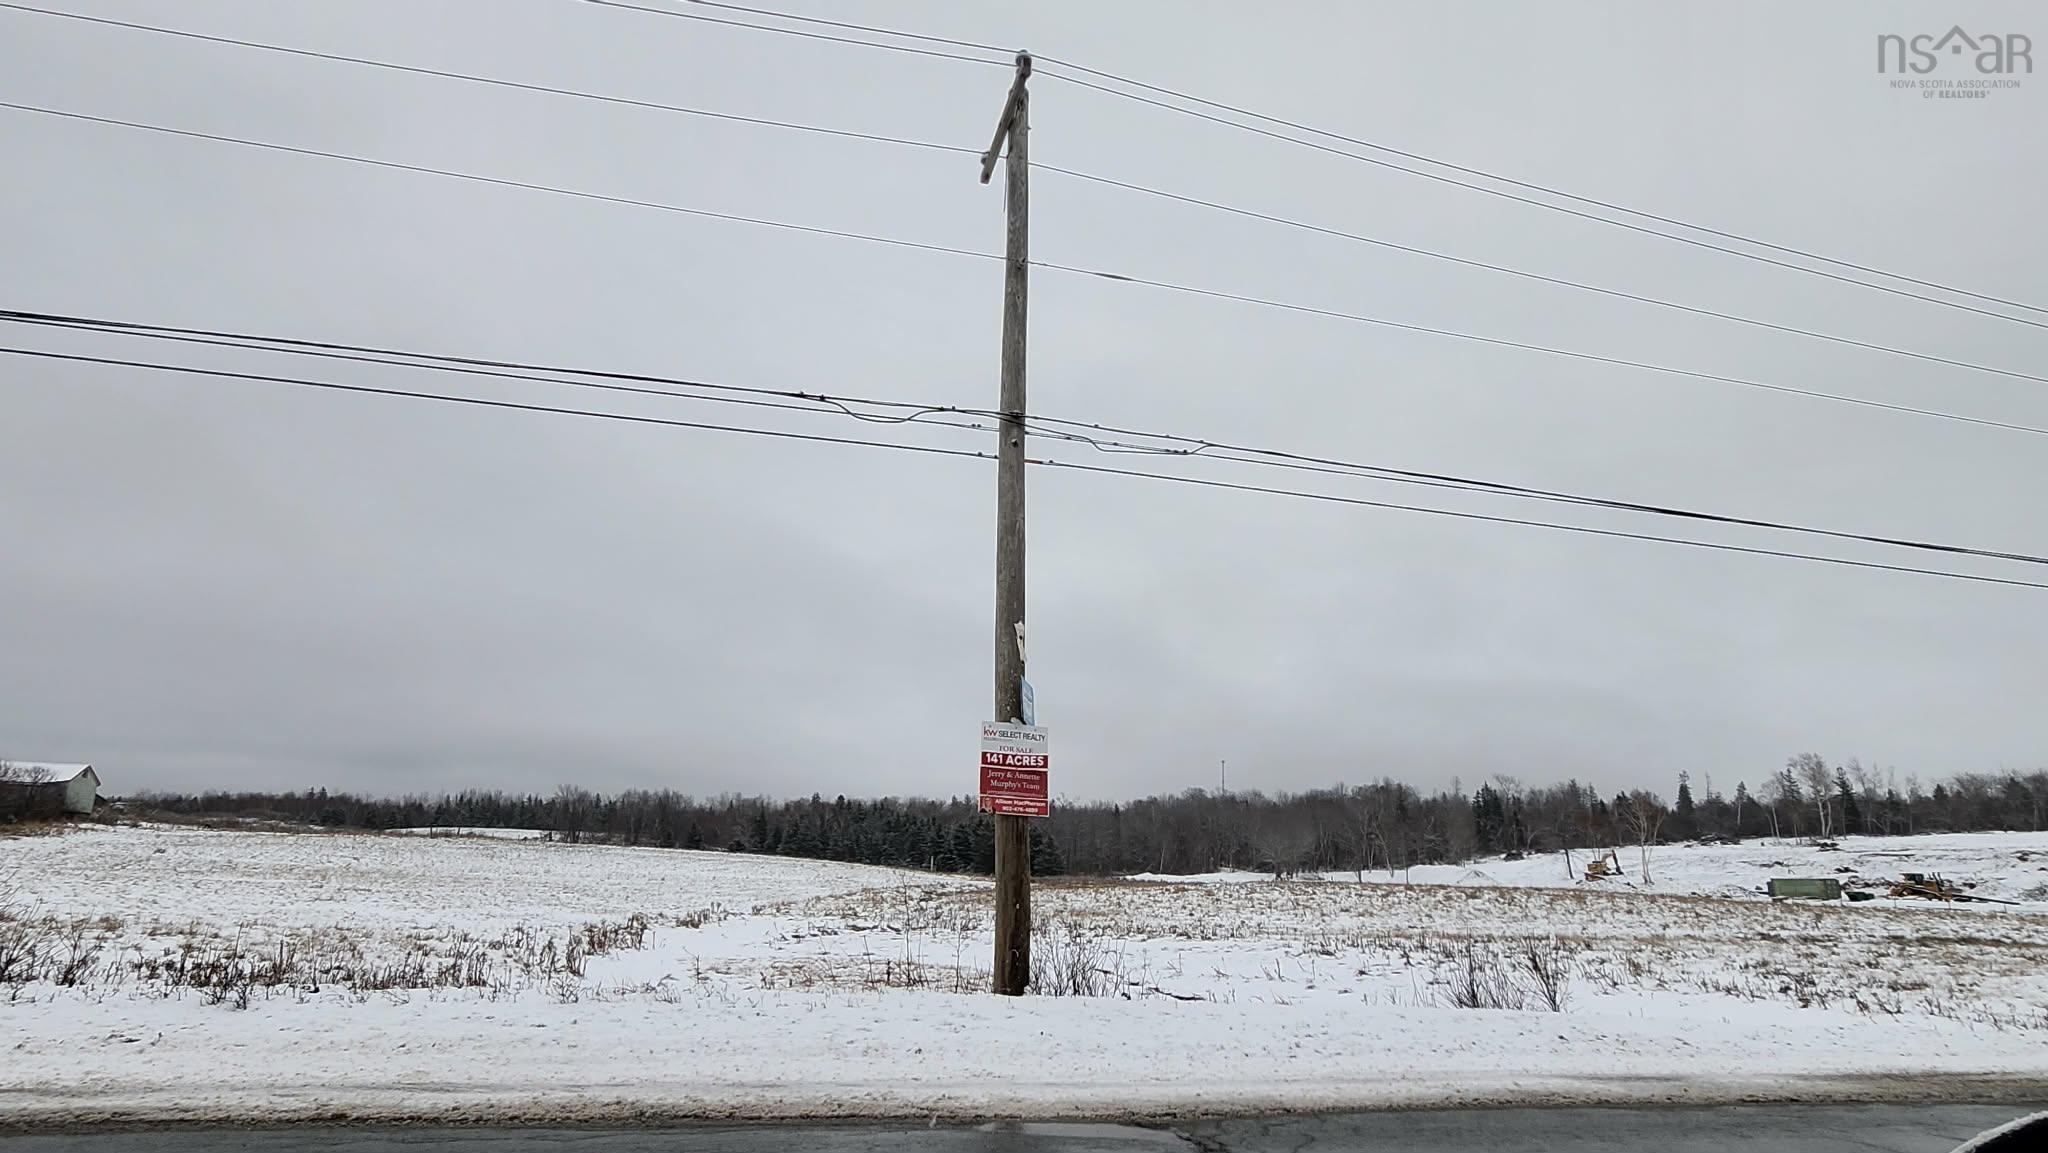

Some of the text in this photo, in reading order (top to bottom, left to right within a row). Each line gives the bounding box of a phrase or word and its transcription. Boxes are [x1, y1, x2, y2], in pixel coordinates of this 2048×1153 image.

[998, 730, 1022, 739] SELECT
[1022, 732, 1046, 742] REALTY
[985, 753, 1044, 766] 141 ACRES
[987, 769, 1005, 779] Jerry
[1014, 771, 1041, 780] Annette
[990, 779, 1040, 790] Murphy's Team
